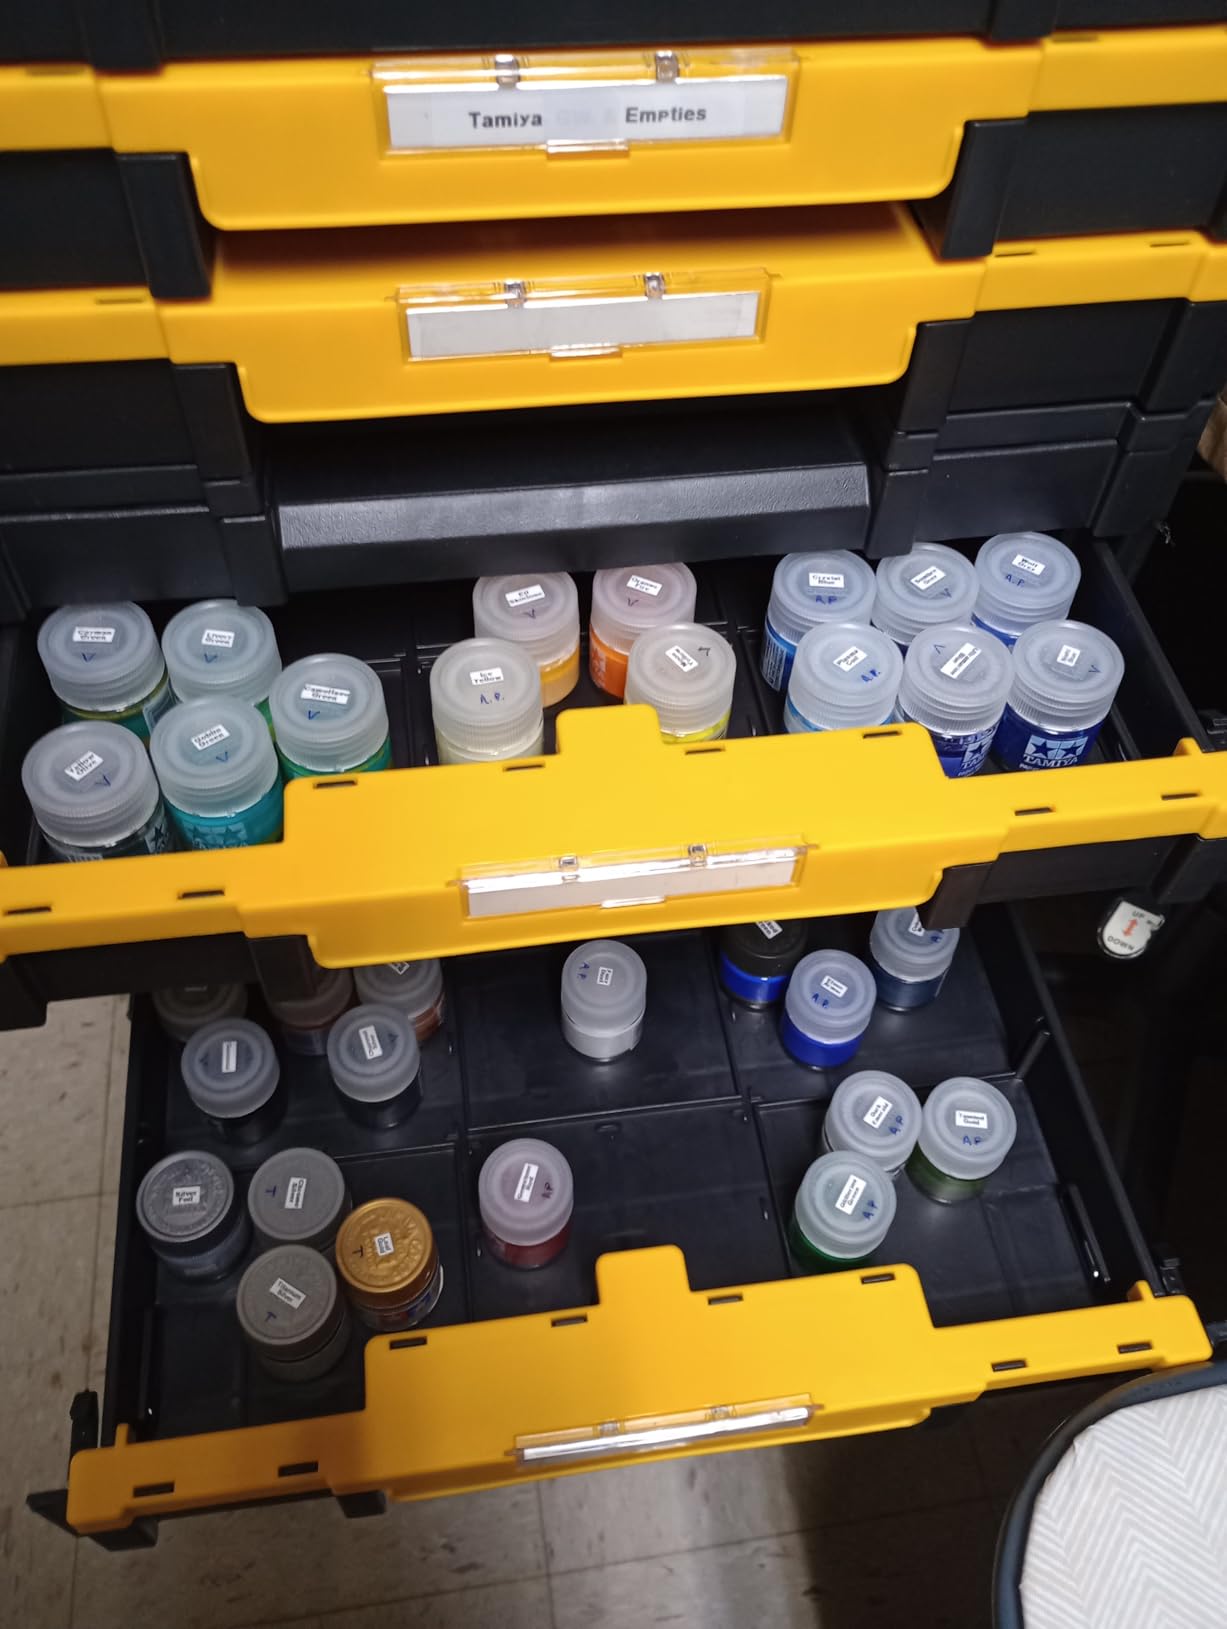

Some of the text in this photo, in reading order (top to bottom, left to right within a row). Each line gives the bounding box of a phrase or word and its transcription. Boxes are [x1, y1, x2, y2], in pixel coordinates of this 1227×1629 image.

[468, 112, 543, 128] Tamiya
[625, 107, 707, 123] Empties
[1022, 754, 1078, 768] TAMIYA
[1107, 936, 1135, 951] DOWN
